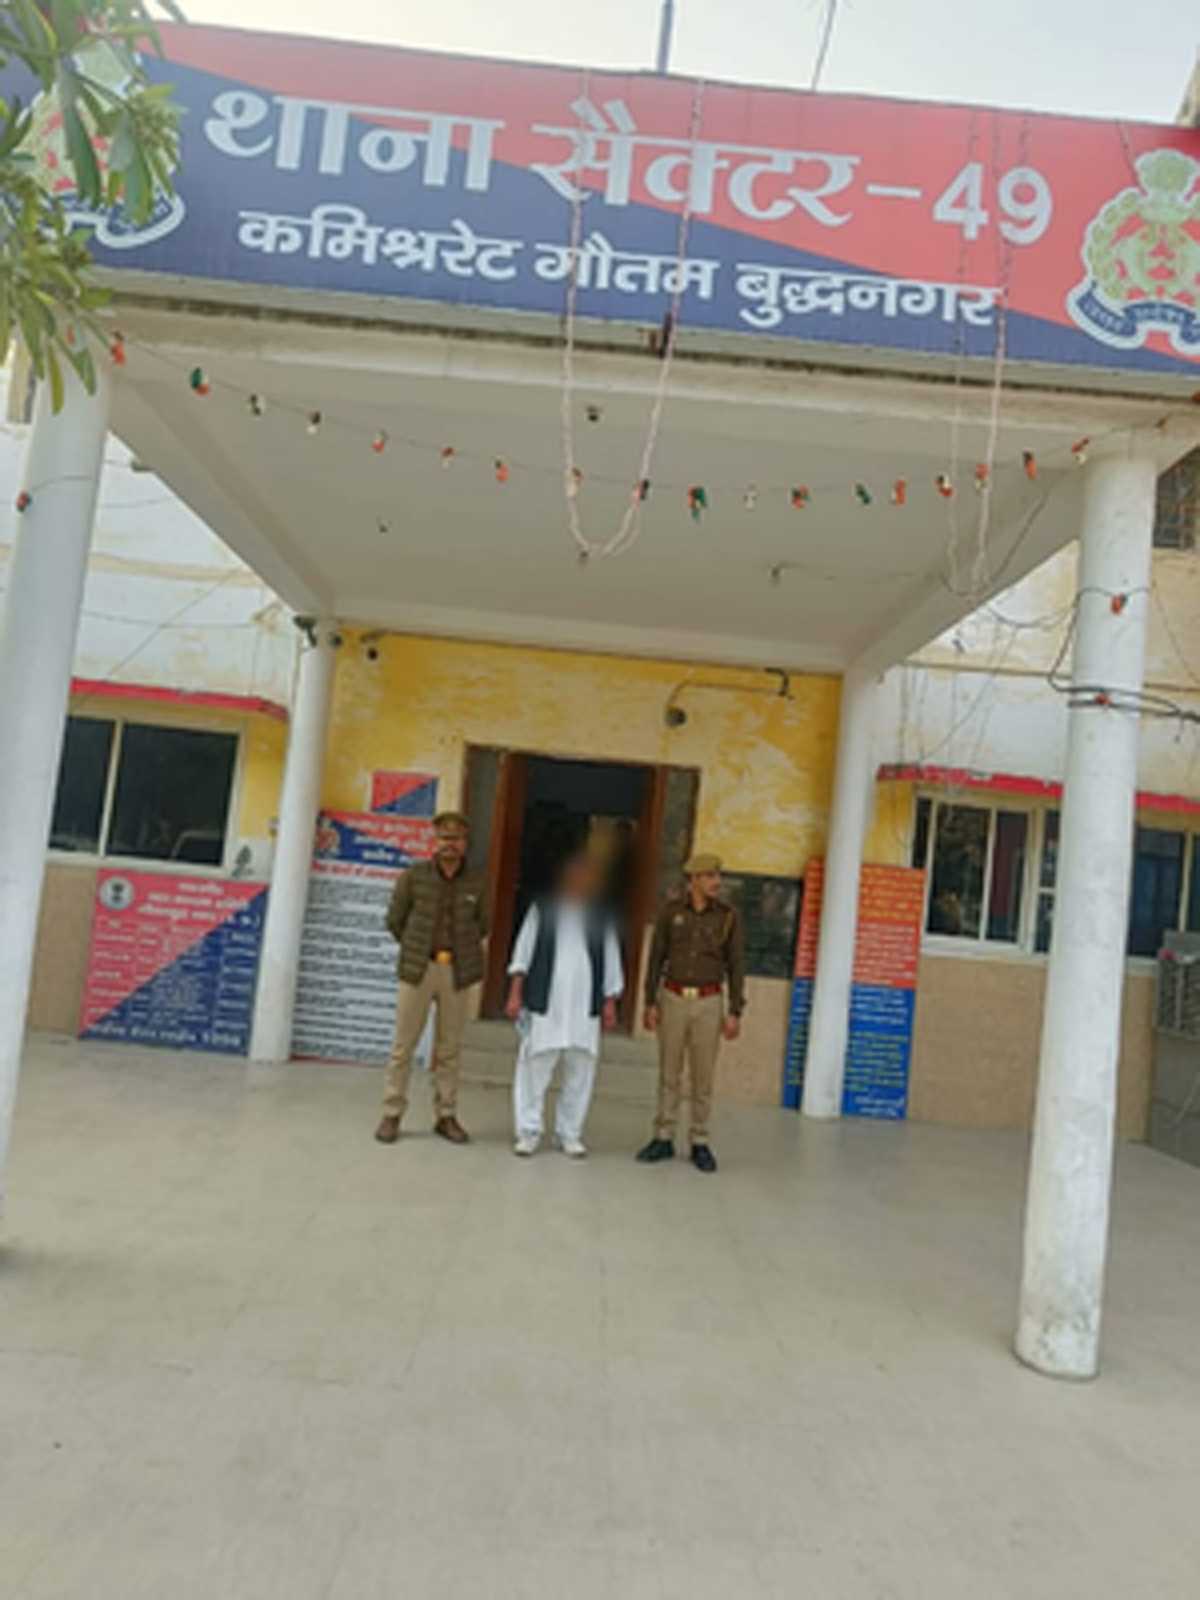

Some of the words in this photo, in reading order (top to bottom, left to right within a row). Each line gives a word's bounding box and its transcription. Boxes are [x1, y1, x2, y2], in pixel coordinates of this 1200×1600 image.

[204, 90, 505, 191] थाना
[534, 230, 720, 299] गौतम
[736, 262, 1004, 328] बुद्धनगर
